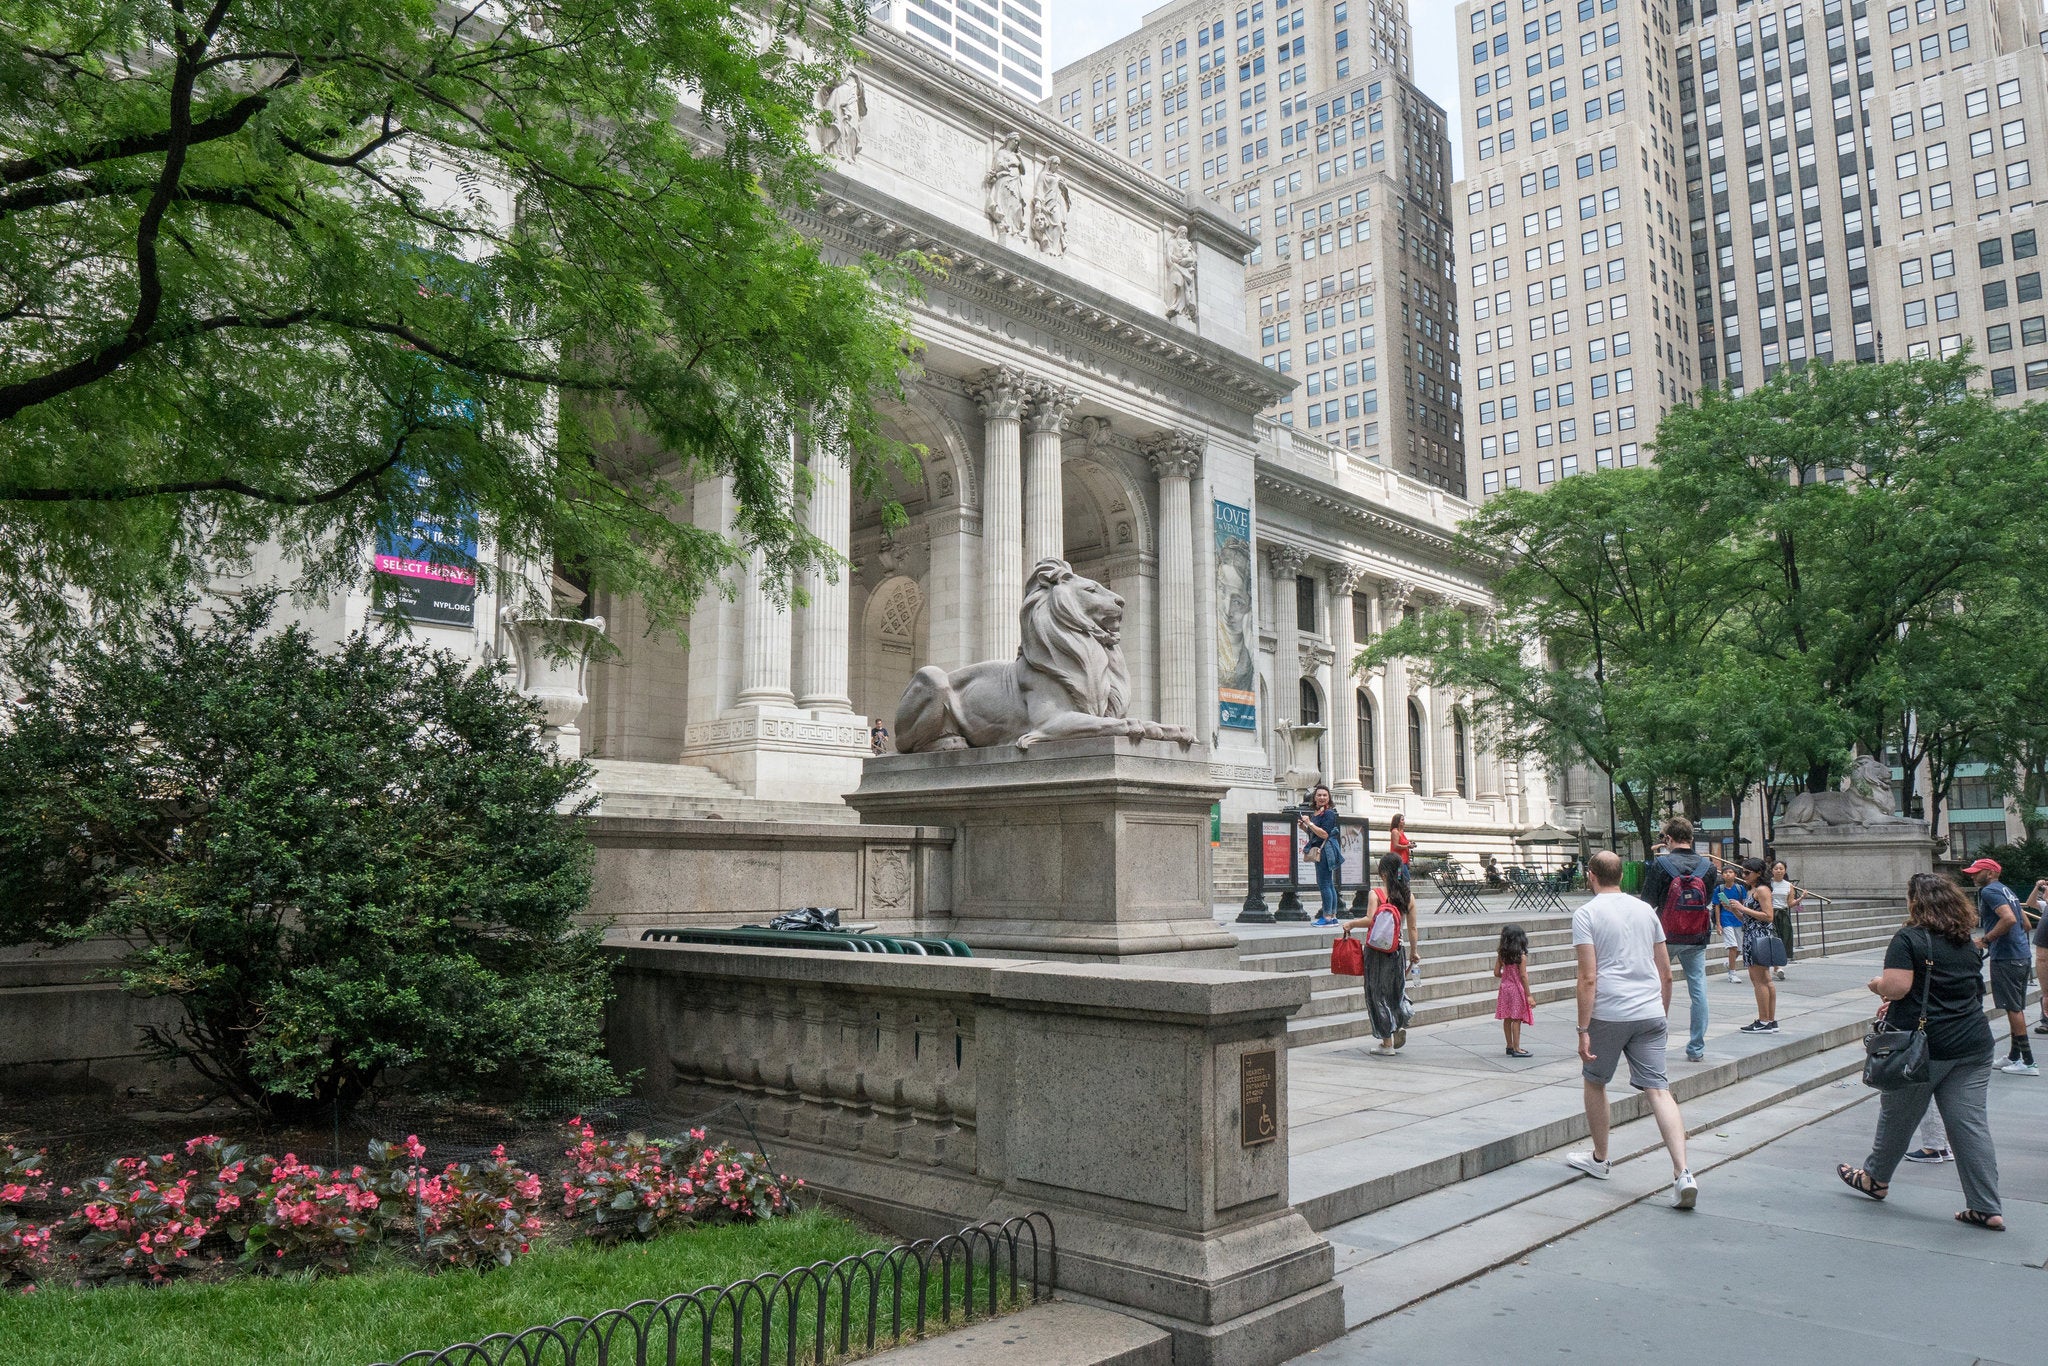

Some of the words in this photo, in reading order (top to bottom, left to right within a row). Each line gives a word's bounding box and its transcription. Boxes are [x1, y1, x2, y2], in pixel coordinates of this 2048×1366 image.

[865, 87, 886, 111] THE
[893, 101, 929, 132] LENOX
[936, 123, 979, 157] LIBRARY
[890, 127, 920, 151] JAMES
[927, 145, 958, 169] LENOX
[1089, 202, 1119, 228] TILDEN
[1126, 221, 1152, 245] TRUST
[946, 296, 1017, 340] PUBLIC
[1033, 332, 1108, 378] LIBRARY
[1215, 503, 1248, 528] LOVE
[383, 559, 422, 574] SELECT
[425, 565, 470, 581] FRIDAYS
[433, 600, 471, 612] NYPL.ORG
